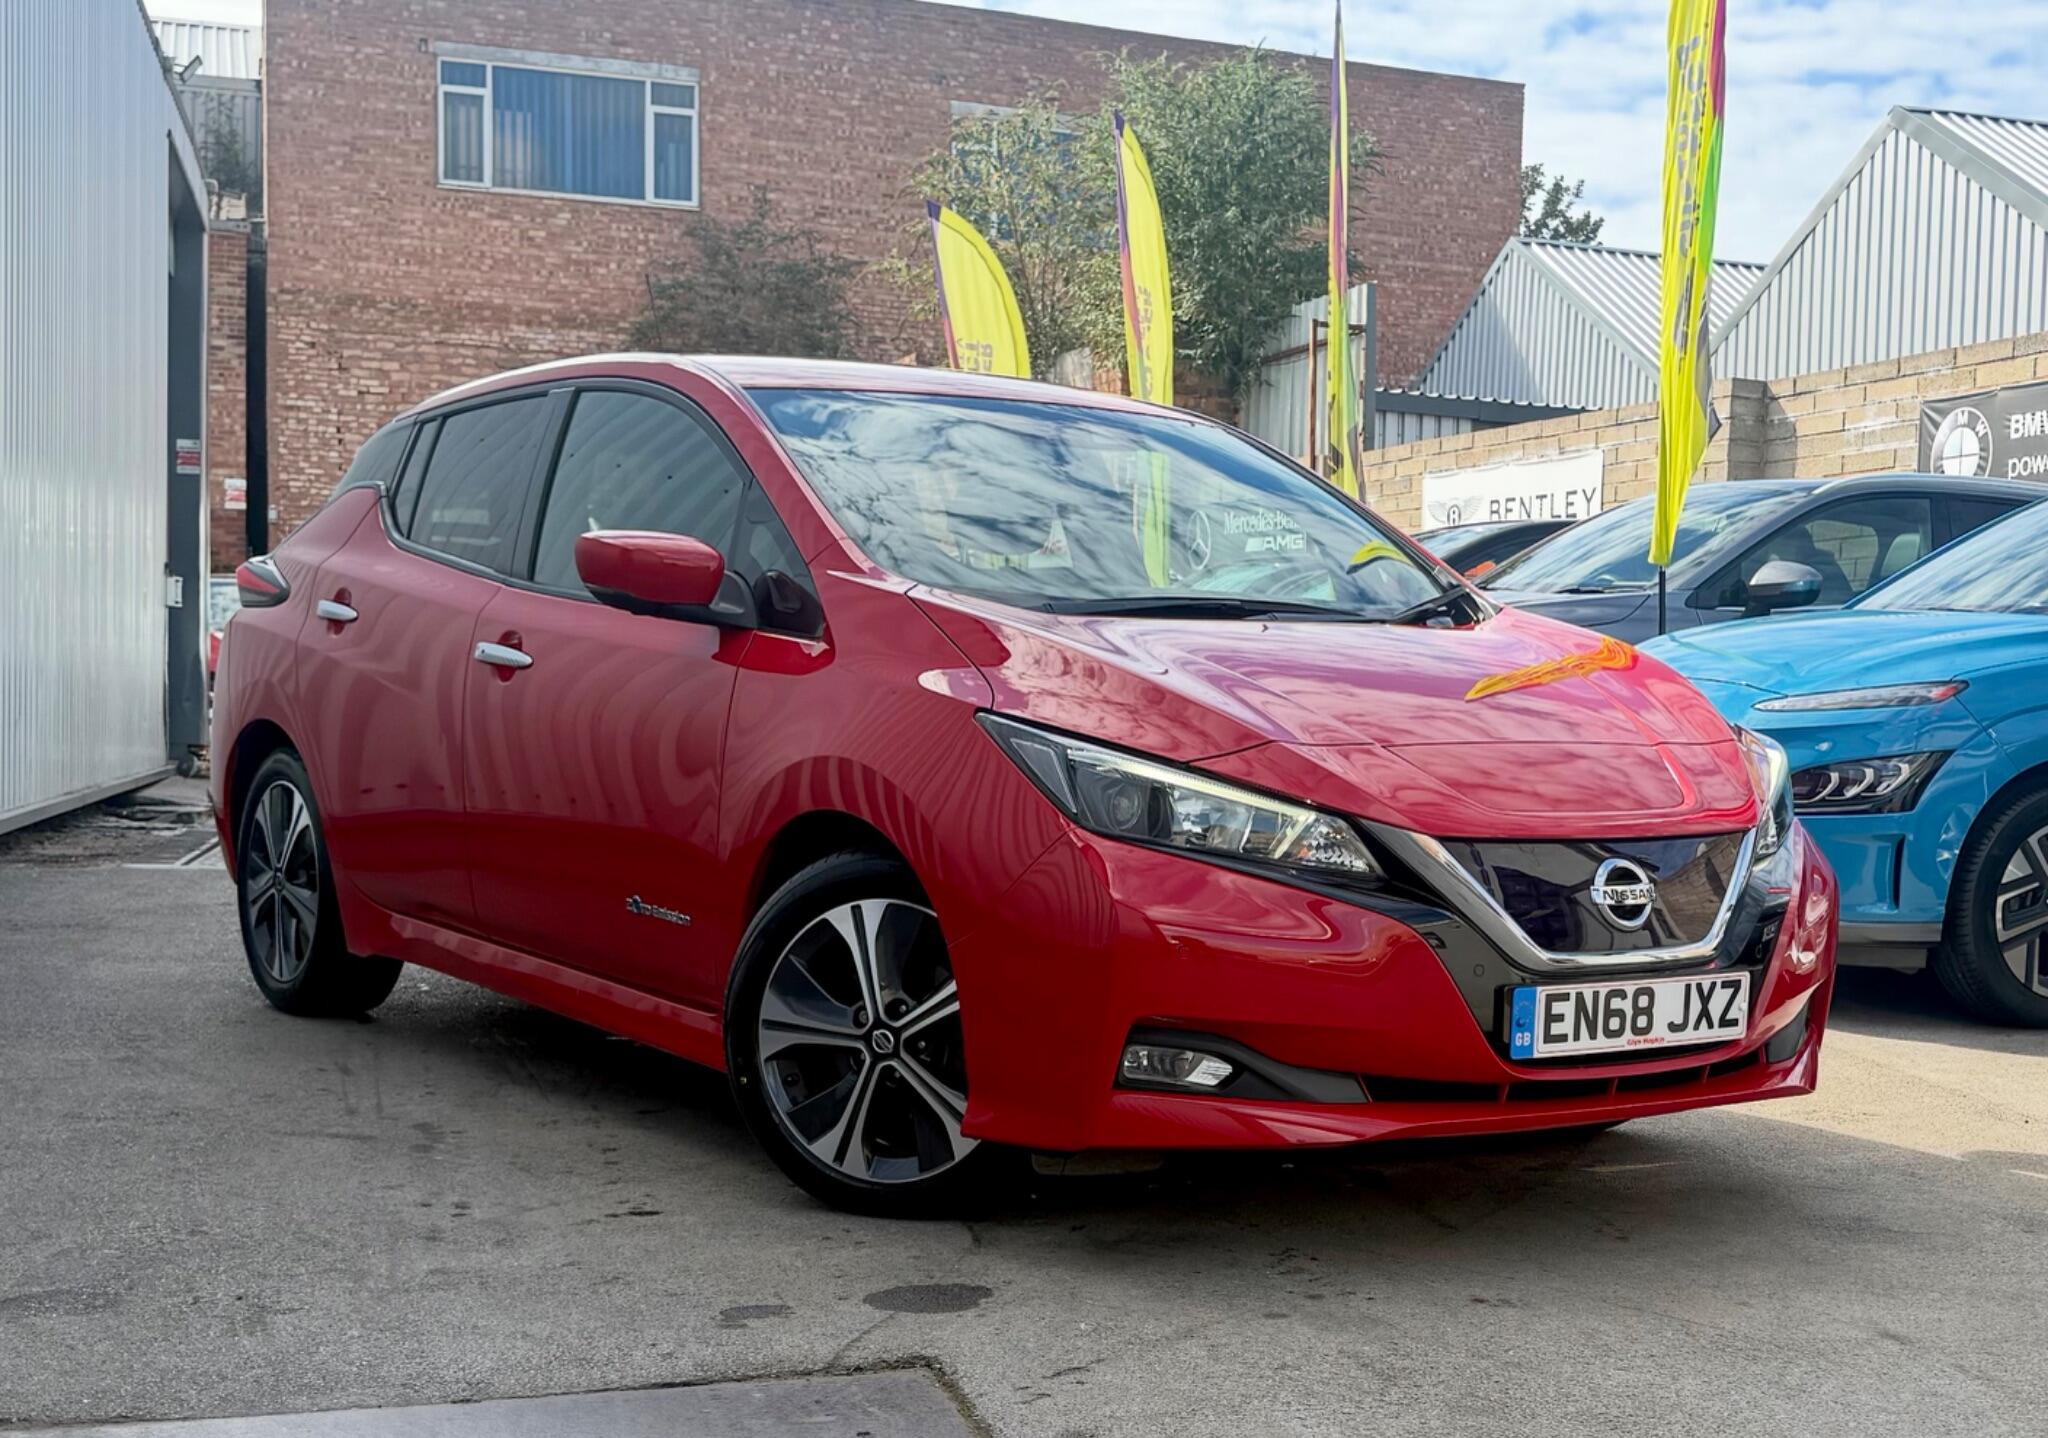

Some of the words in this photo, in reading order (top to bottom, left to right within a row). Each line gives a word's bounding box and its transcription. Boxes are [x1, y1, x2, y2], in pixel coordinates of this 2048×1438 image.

[2008, 455, 2048, 480] pow
[1489, 487, 1597, 521] BENTLEY
[1262, 533, 1304, 551] AMG
[1602, 886, 1653, 901] NISSAN
[1543, 987, 1655, 1044] EN68
[1667, 979, 1742, 1033] JXZ
[1515, 1032, 1531, 1046] GB
